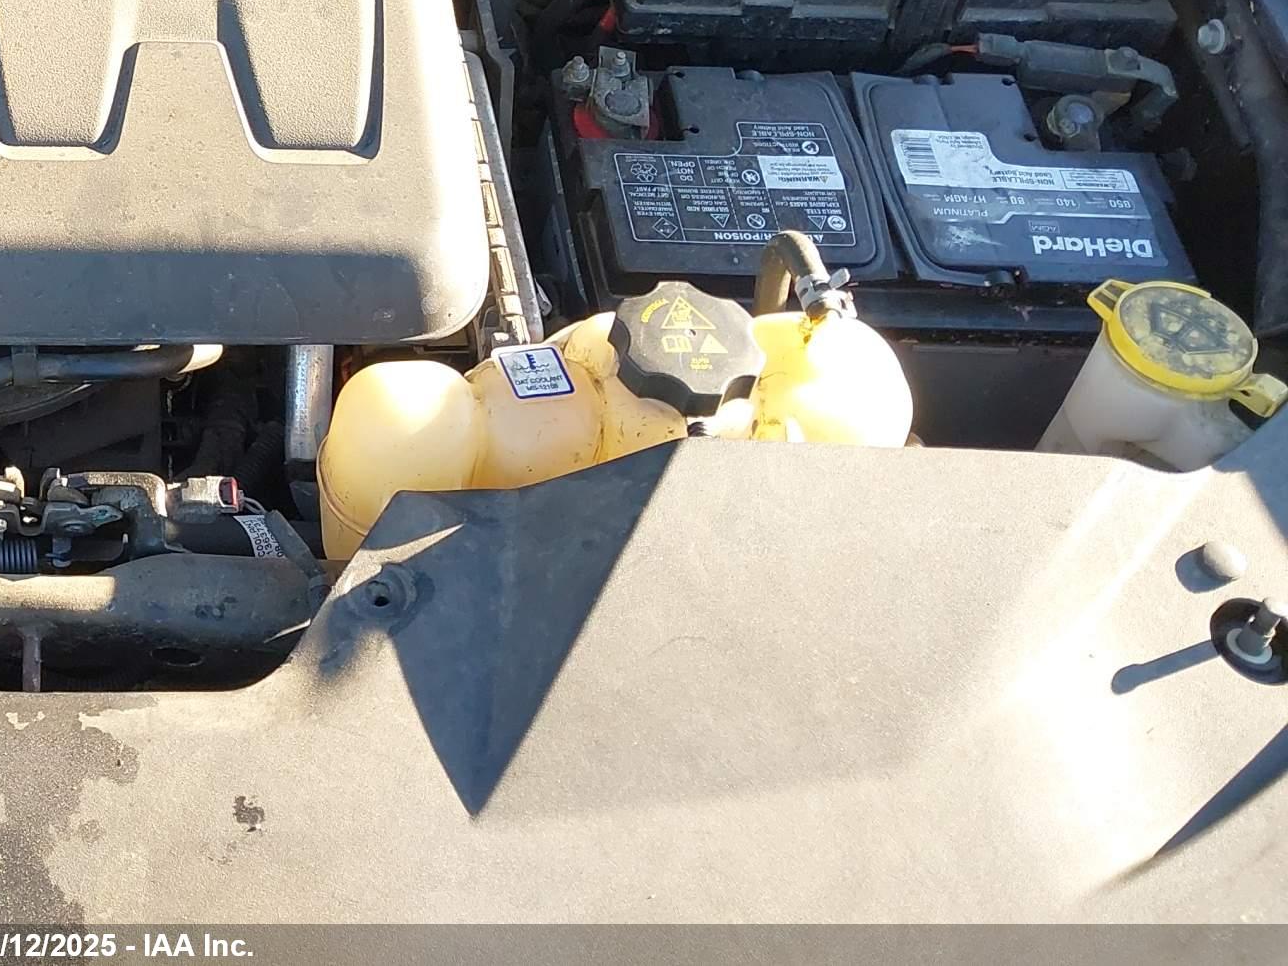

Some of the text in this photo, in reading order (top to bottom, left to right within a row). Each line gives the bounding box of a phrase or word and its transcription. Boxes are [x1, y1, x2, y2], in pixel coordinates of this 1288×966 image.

[992, 176, 1054, 185] NON-SPILLABLE
[1009, 196, 1025, 205] 80
[1056, 198, 1077, 207] 140
[1108, 199, 1131, 208] 850
[933, 208, 988, 217] PLATINUM
[1032, 235, 1153, 258] DieHard
[530, 375, 562, 384] COOLANT
